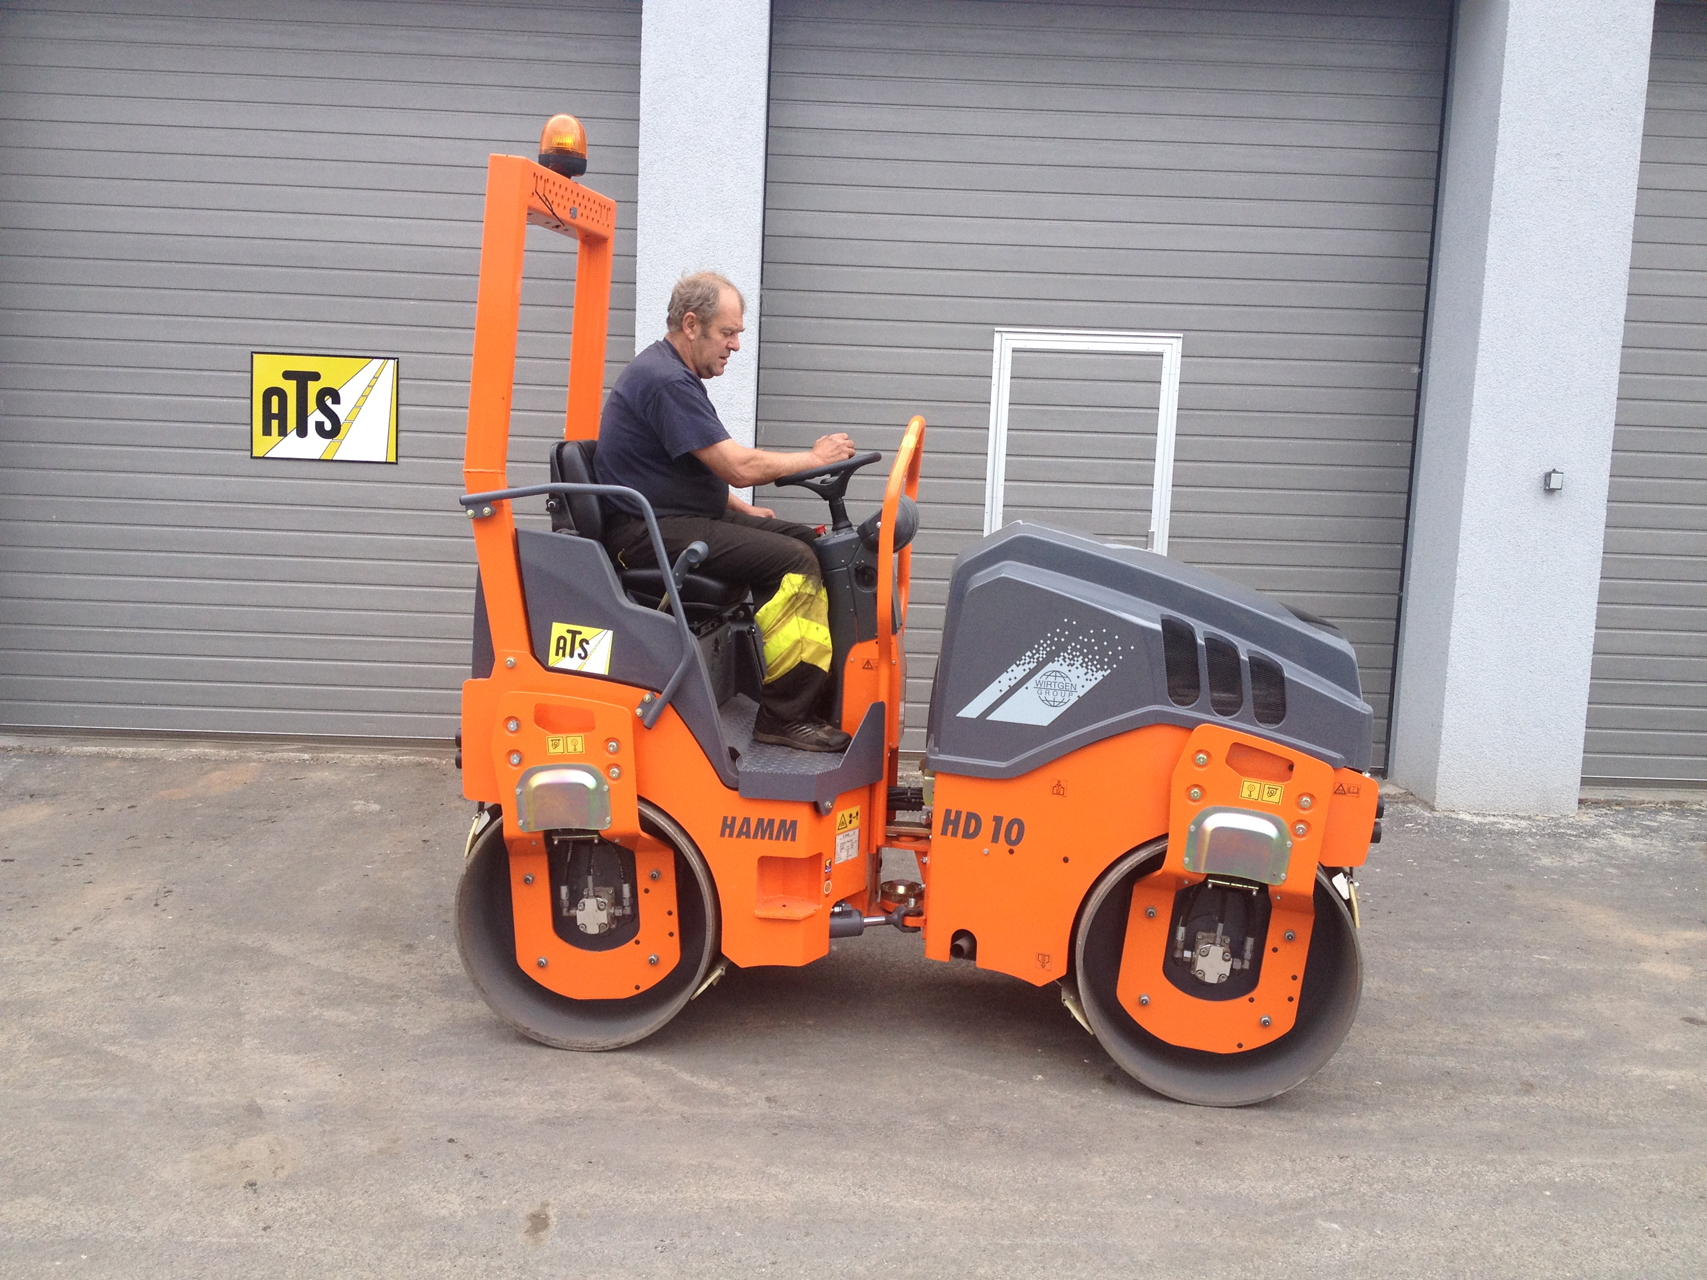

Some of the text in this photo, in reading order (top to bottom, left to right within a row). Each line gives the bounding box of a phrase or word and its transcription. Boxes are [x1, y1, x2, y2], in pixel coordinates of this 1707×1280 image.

[262, 370, 341, 439] ATS
[555, 629, 589, 660] ATS
[1035, 680, 1077, 691] WIRTGEN
[1037, 689, 1073, 698] GROUP
[720, 816, 798, 842] HAMM
[940, 808, 1025, 847] HD 10
